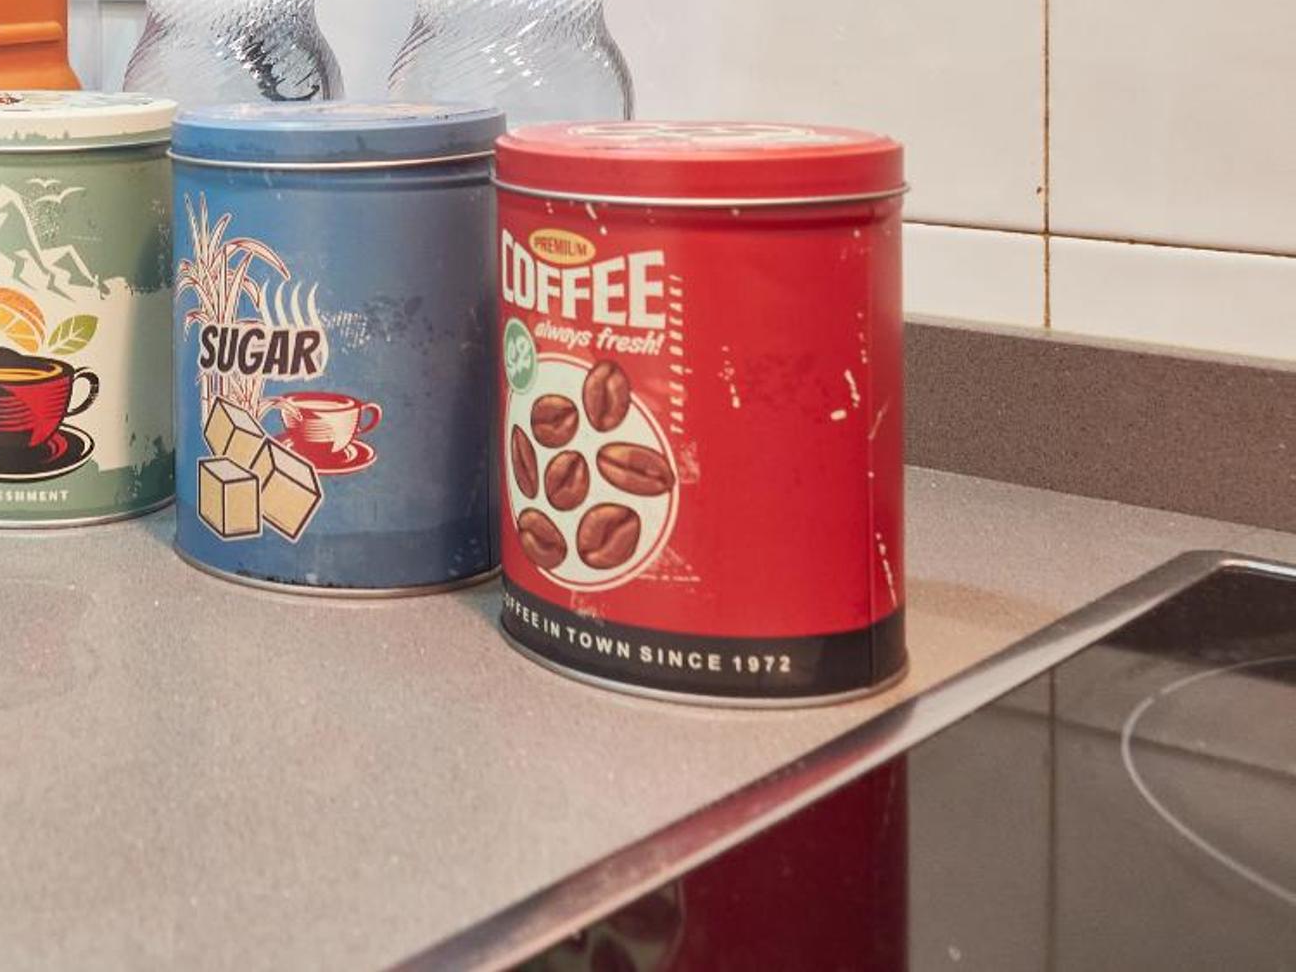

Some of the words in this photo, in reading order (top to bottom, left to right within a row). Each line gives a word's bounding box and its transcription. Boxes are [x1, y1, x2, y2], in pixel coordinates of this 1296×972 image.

[533, 235, 588, 257] PREMIUM
[501, 228, 667, 330] COFFEE
[200, 325, 322, 375] SUGAR
[534, 320, 593, 349] always
[596, 327, 665, 355] fresh!
[543, 617, 561, 639] IN
[566, 626, 630, 660] TOWN
[639, 644, 722, 671] SINCE
[732, 654, 791, 674] 1972
